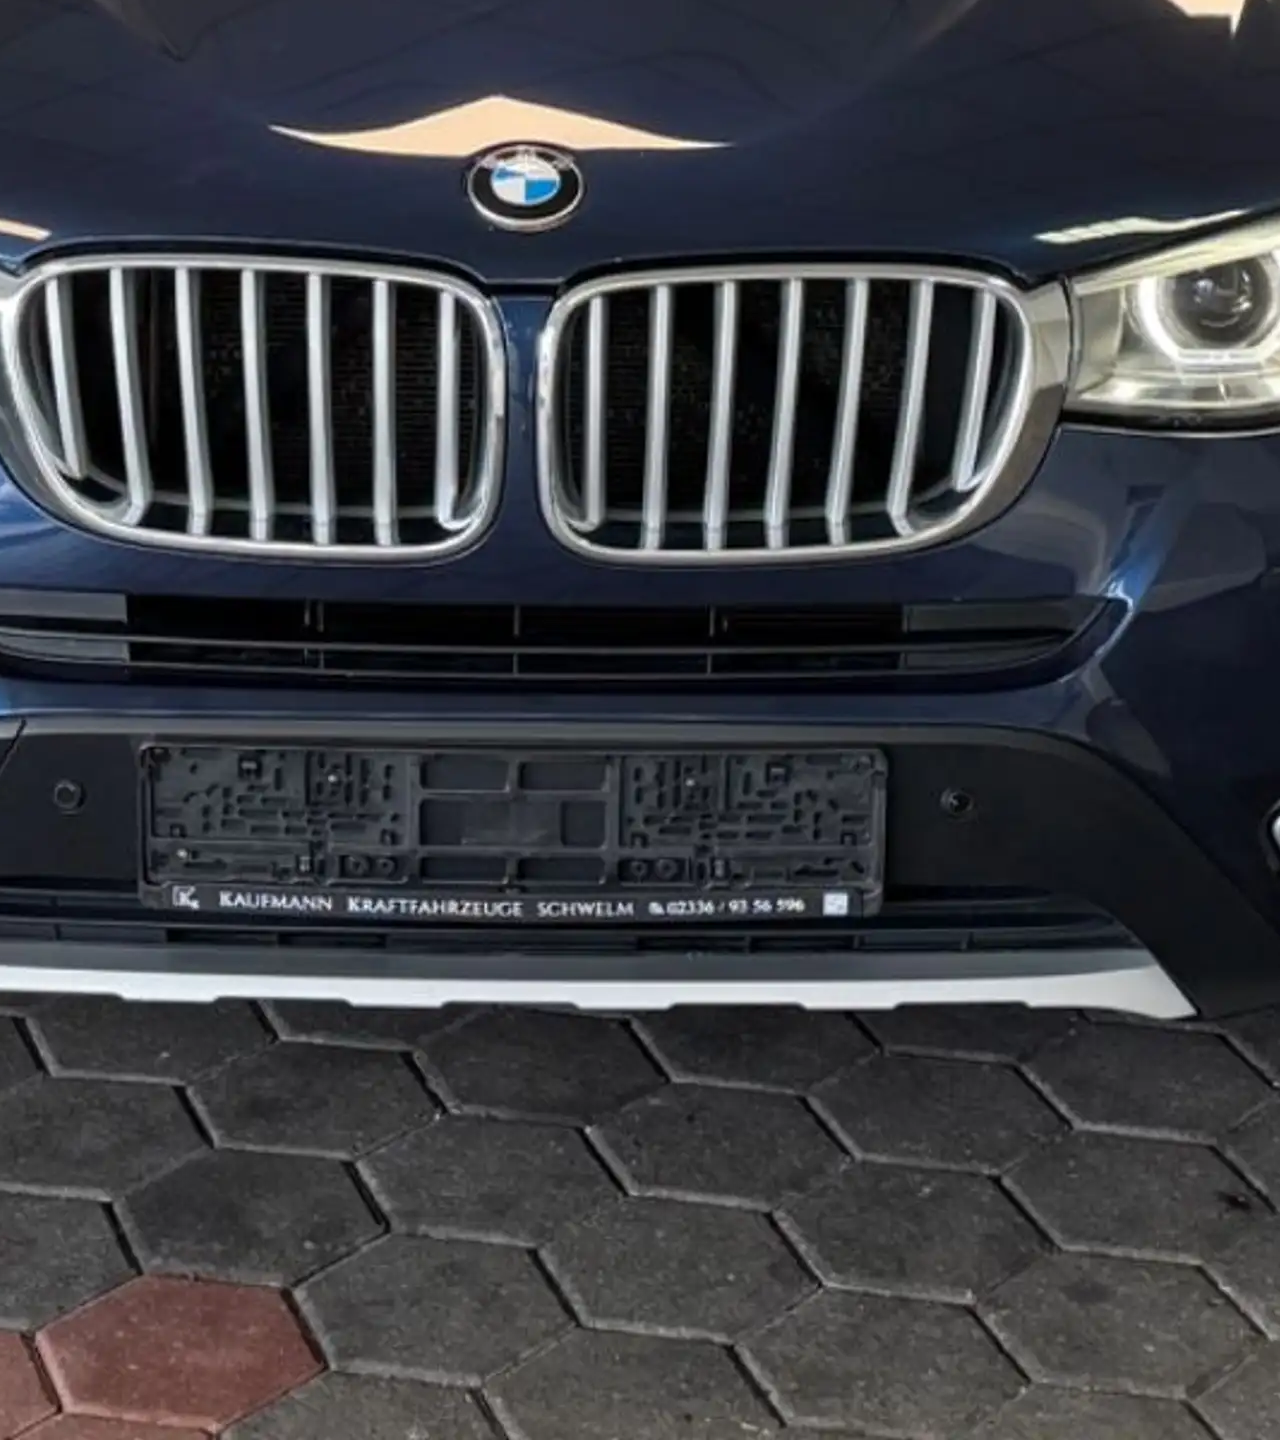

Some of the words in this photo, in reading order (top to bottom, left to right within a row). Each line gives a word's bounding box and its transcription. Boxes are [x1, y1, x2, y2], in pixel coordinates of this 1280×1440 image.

[219, 890, 333, 911] KAUFMANN
[346, 895, 524, 918] KRAFTFAHRZEUGE
[536, 900, 634, 918] SCHWELM
